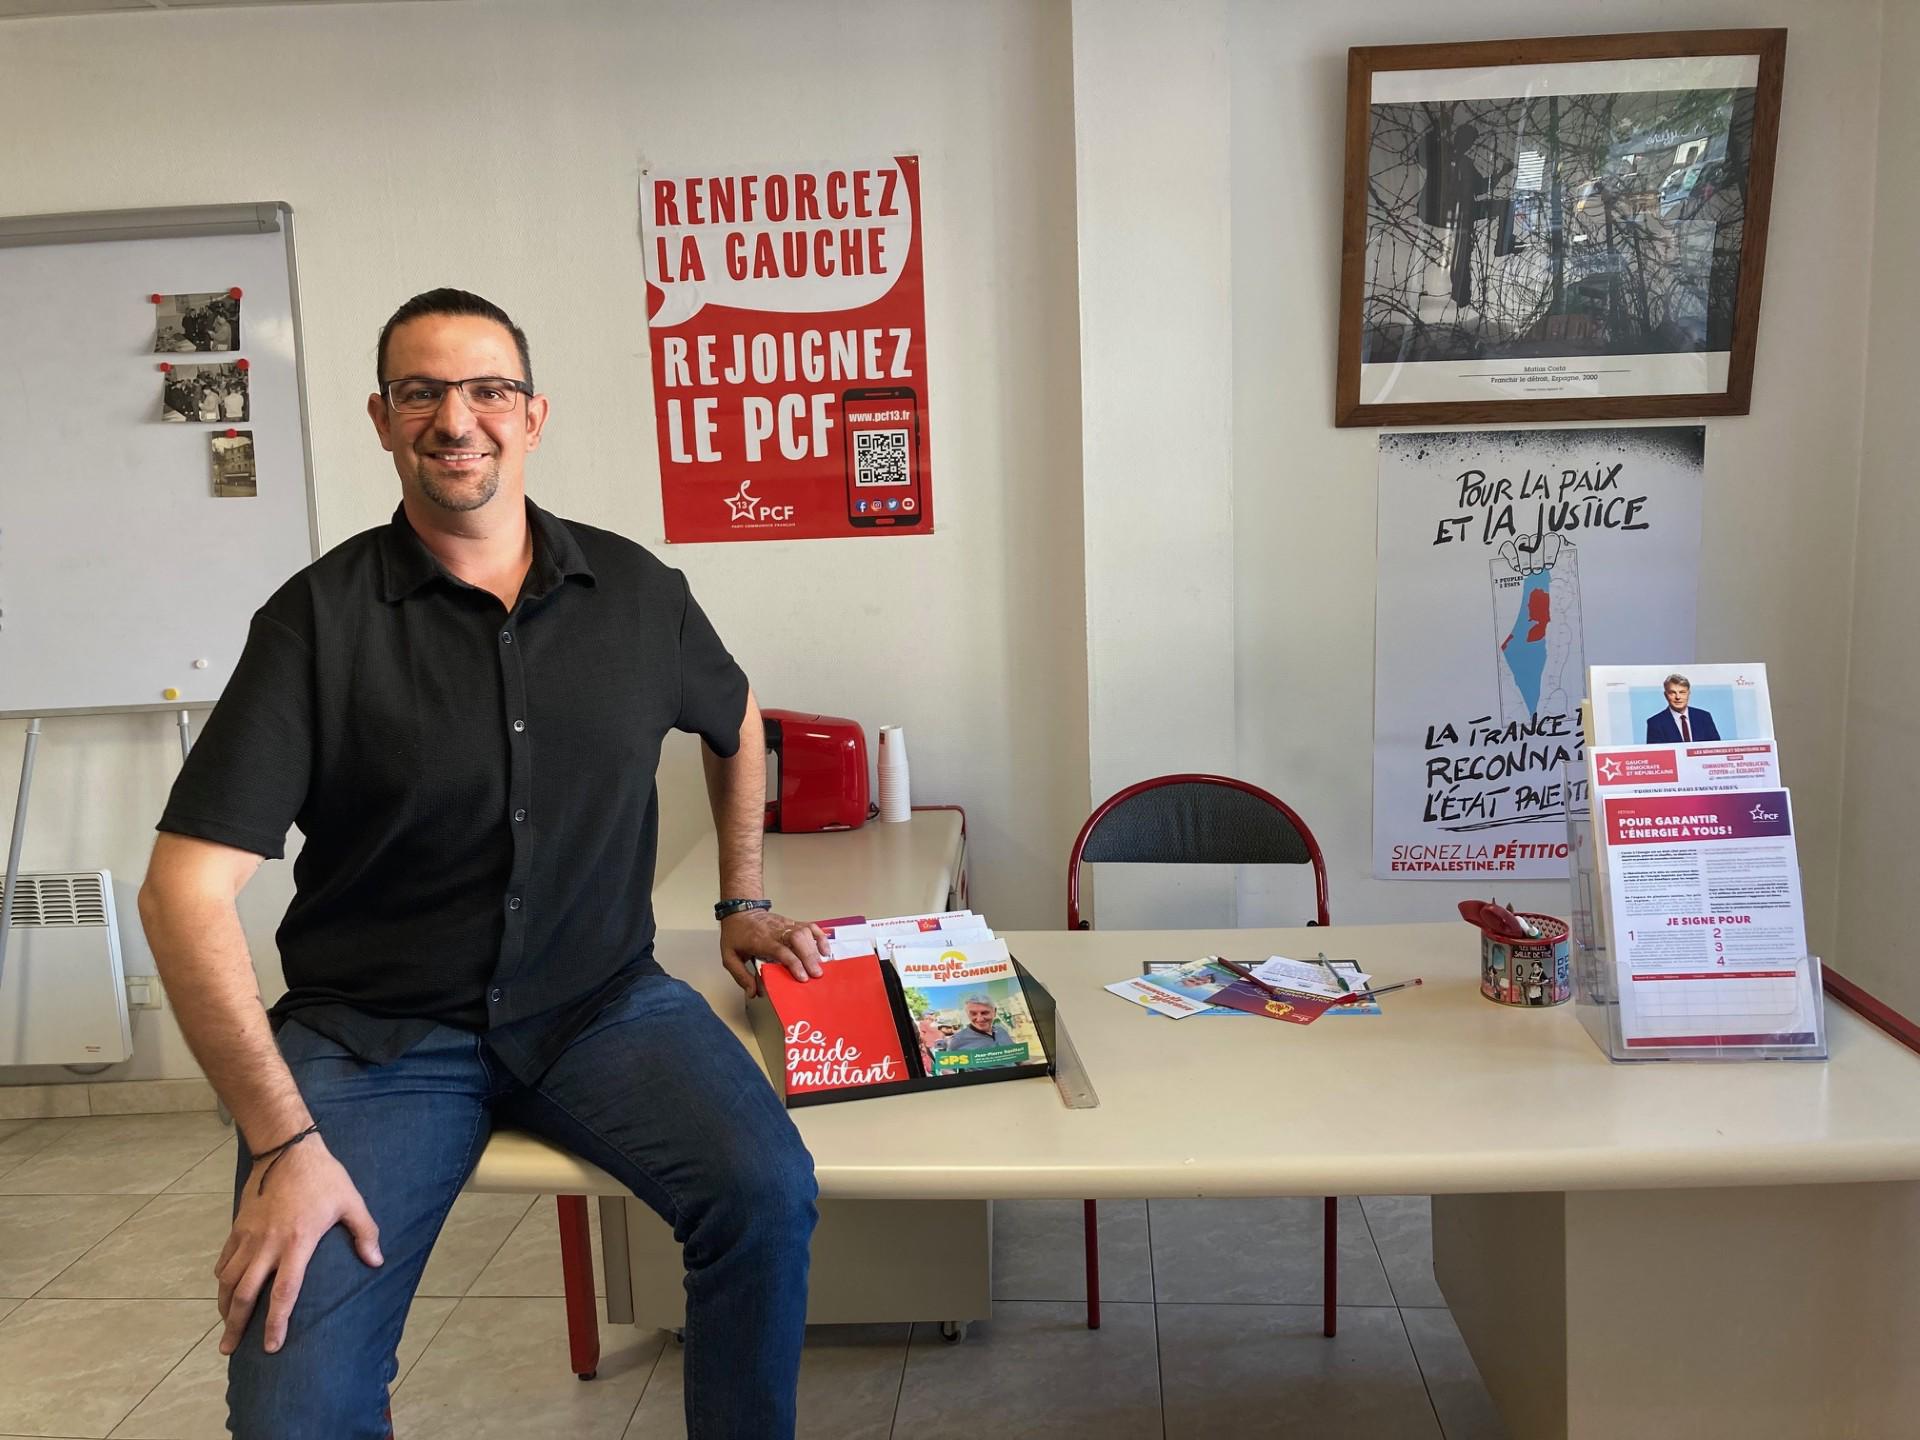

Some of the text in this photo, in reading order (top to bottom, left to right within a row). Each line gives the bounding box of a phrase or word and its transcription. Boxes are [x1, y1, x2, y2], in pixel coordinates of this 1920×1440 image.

[654, 169, 899, 226] RENFORCEZ
[656, 227, 887, 283] LA GAUCHE
[663, 328, 912, 387] REJOIGNEZ
[848, 410, 910, 422] www.pcf13.fr
[667, 392, 836, 464] LE PCF
[1456, 462, 1623, 508] POUR LA PAIX
[736, 501, 748, 509] 13
[760, 506, 794, 520] PCF
[1432, 495, 1650, 553] ET LA JUSTICE
[1424, 723, 1459, 750] LA
[1468, 712, 1571, 747] FRANCE
[1423, 784, 1511, 822] L'ÉTAT
[1618, 814, 1719, 827] POUR GARANTIR
[1619, 827, 1679, 839] L'ÉNERGIE
[1681, 825, 1691, 836] À
[1392, 840, 1569, 860] SIGNEZ LA PÉTITIO
[1391, 861, 1515, 871] ETATPALESTINE.FR
[1667, 915, 1752, 926] JE SIGNE POUR
[1628, 930, 1635, 941] 1
[1713, 928, 1722, 938] 2
[1715, 942, 1723, 952] 3
[904, 960, 963, 973] AUBAGNE
[1716, 956, 1725, 966] 4
[934, 970, 950, 982] EN
[952, 963, 1008, 978] COMMUN
[785, 1020, 827, 1044] Le
[786, 1037, 862, 1070] guide
[939, 1055, 969, 1065] JPS
[791, 1055, 902, 1086] militant
